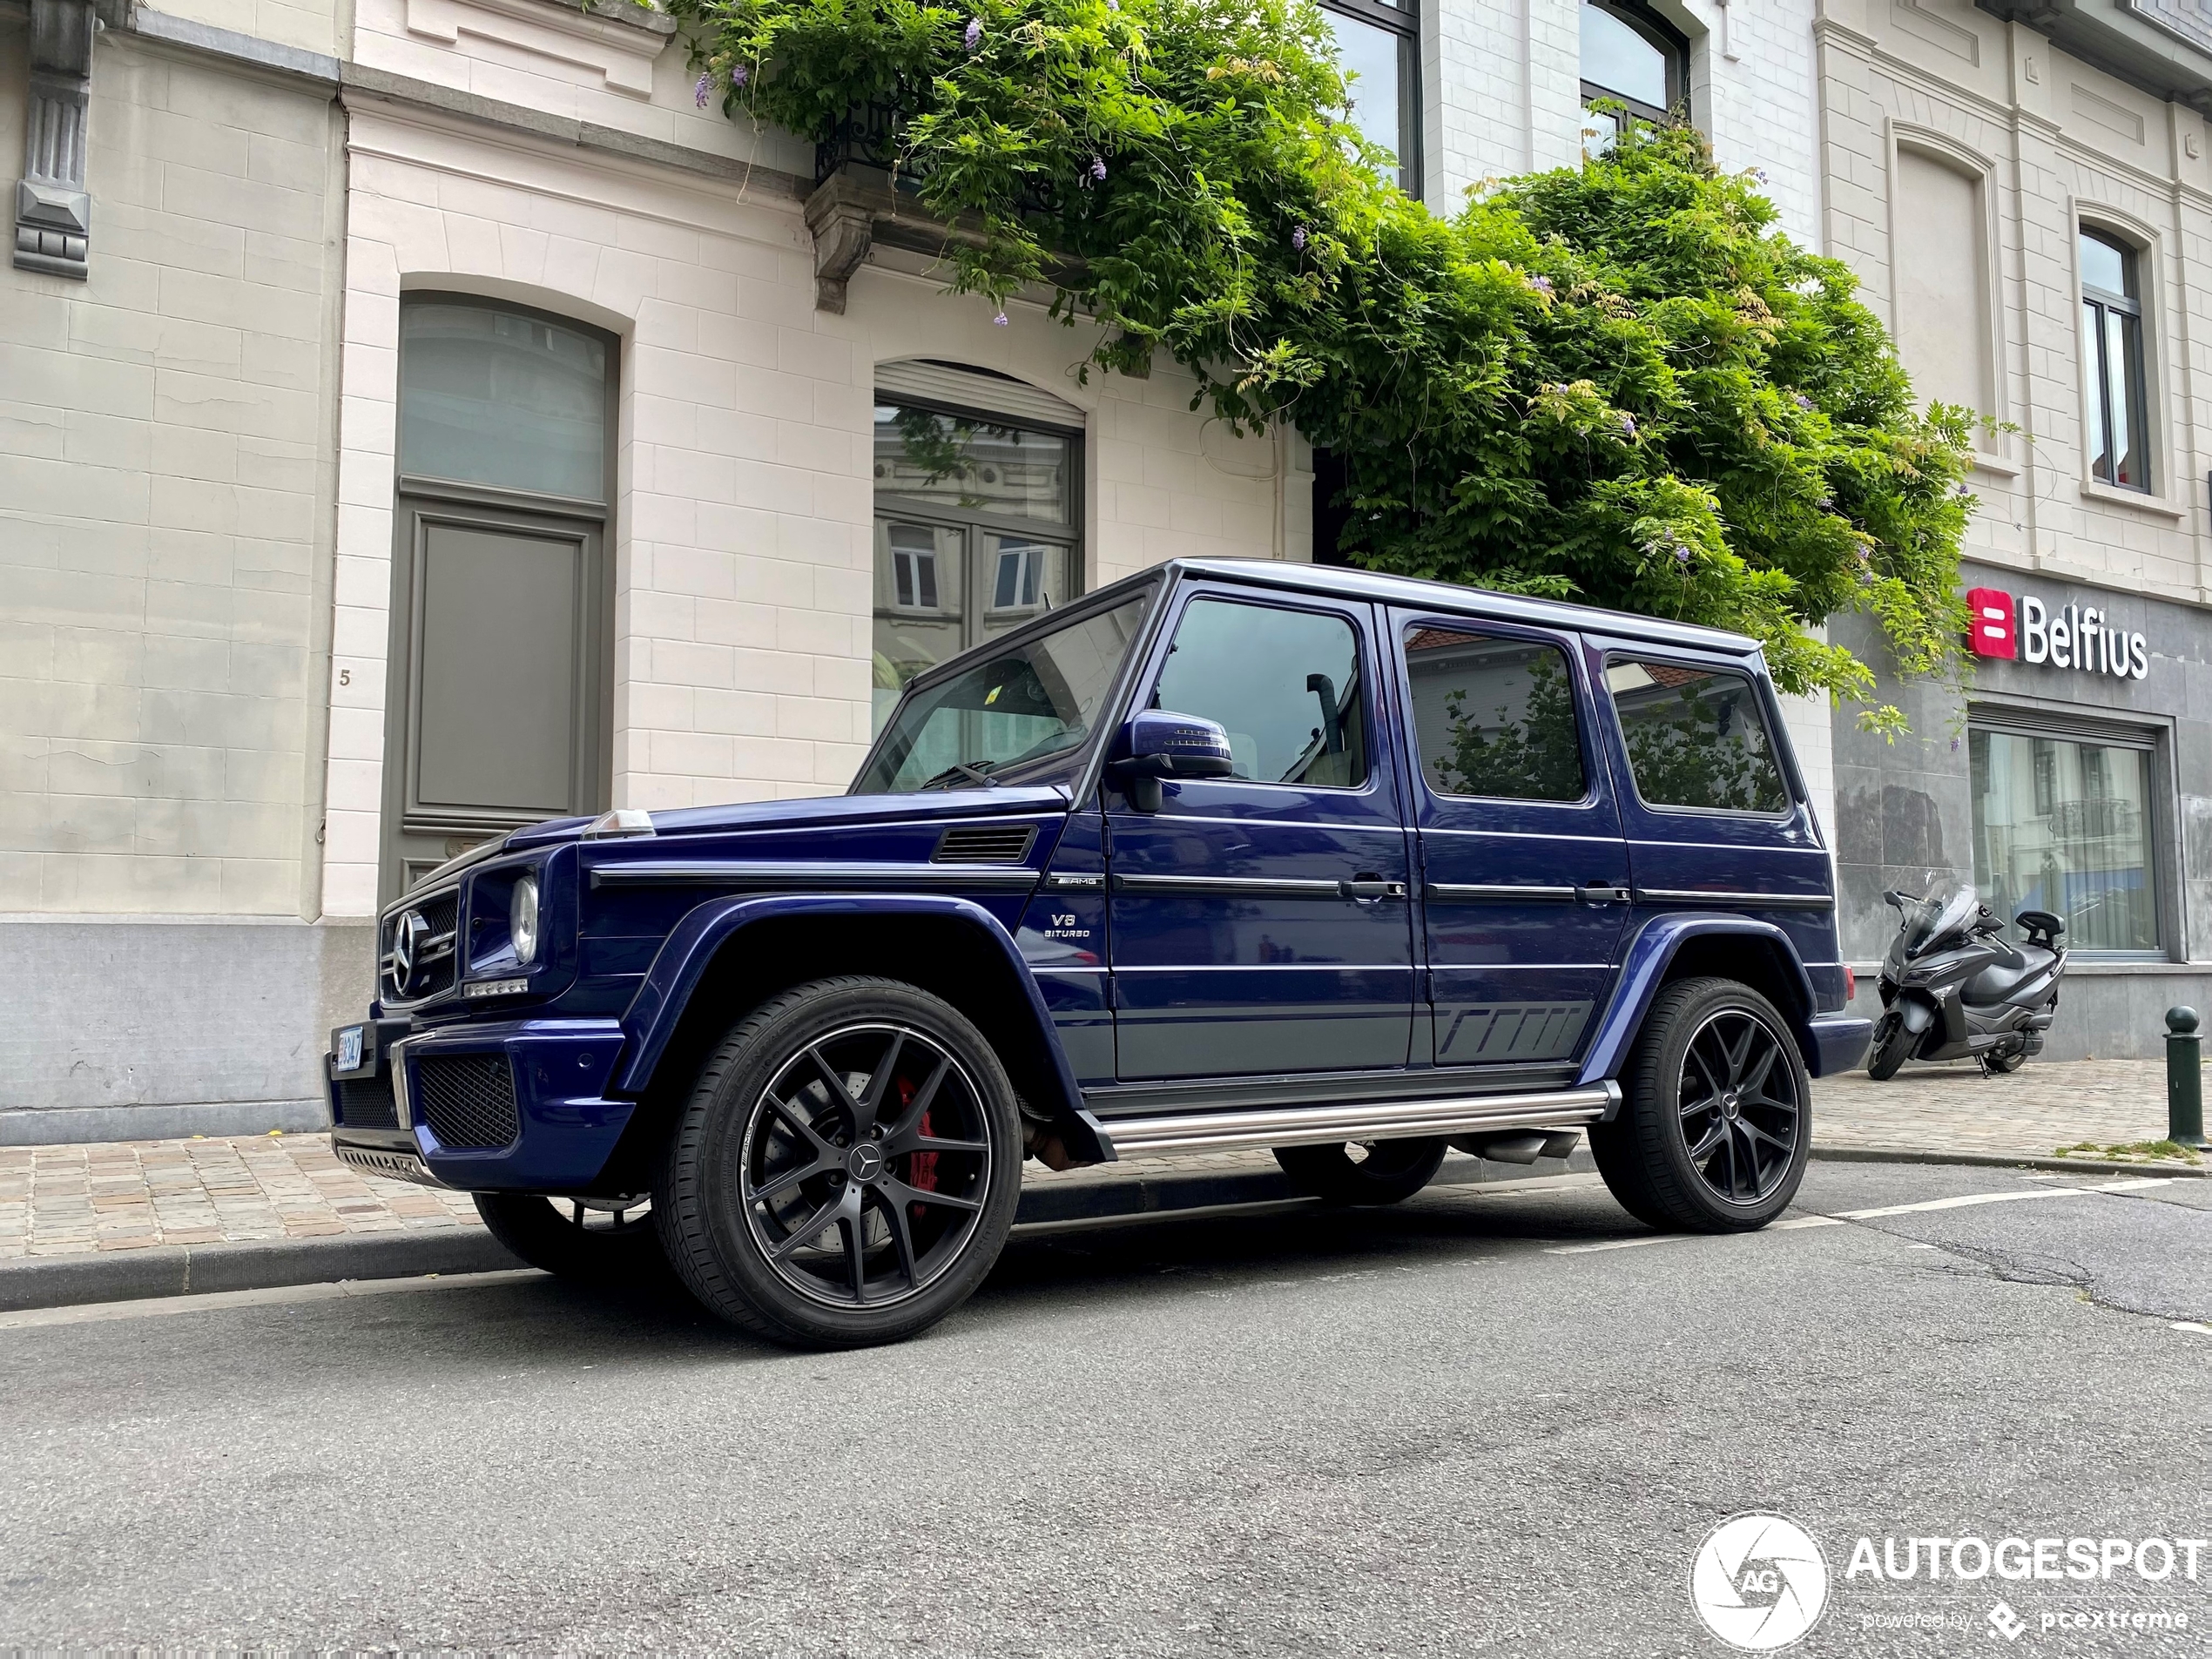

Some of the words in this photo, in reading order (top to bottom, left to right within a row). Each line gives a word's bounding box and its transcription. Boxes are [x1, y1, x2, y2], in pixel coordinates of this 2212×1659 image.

[2017, 595, 2148, 679] Belfius
[340, 670, 350, 686] 5
[1051, 914, 1076, 927] V8
[743, 1126, 753, 1154] AMG
[972, 1228, 991, 1259] UHP
